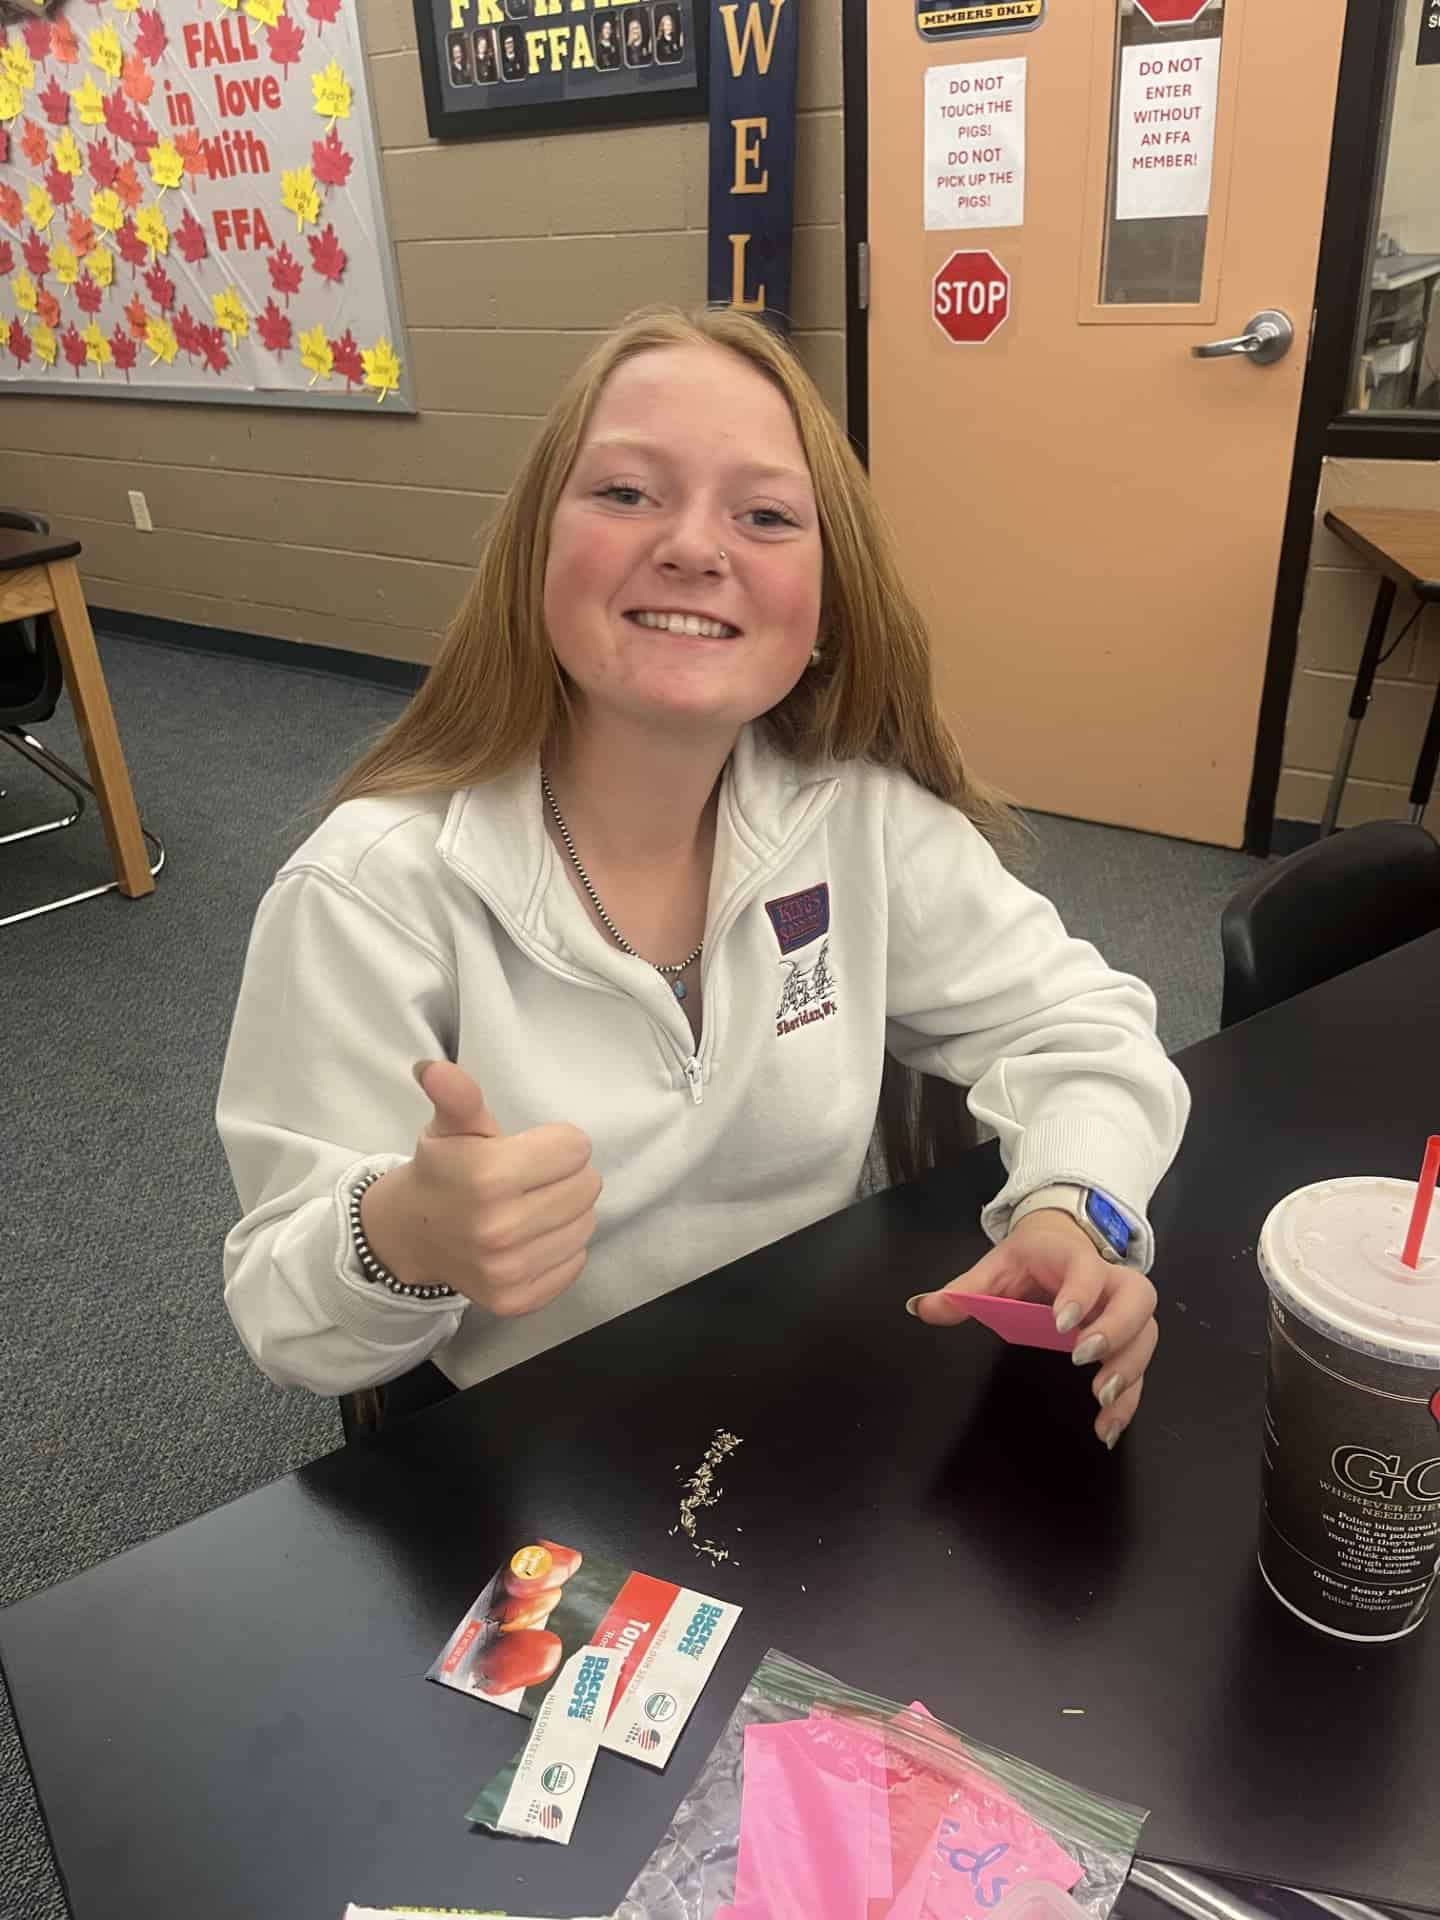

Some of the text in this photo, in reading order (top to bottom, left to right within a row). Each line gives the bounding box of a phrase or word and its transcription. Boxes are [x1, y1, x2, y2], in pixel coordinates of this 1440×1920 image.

[924, 4, 1035, 25] MEMBERS ONLY
[183, 15, 258, 69] FALL
[525, 24, 594, 74] FFA
[1139, 57, 1202, 76] DO NOT
[949, 76, 1004, 94] DO NOT
[1146, 84, 1192, 99] ENTER
[163, 79, 195, 126] in
[214, 74, 281, 117] love
[940, 100, 1013, 119] TOUCH THE
[1134, 107, 1201, 123] WITHOUT
[958, 125, 992, 138] PIGS!
[1140, 131, 1191, 147] AN FFA
[201, 129, 270, 180] With
[718, 0, 784, 313] WEL
[948, 148, 1002, 165] DO NOT
[1132, 154, 1197, 169] MEMBER!
[937, 171, 1014, 189] PICK UP THE
[958, 195, 991, 209] PIGS!
[212, 207, 275, 251] FFA
[936, 280, 1006, 315] STOP
[1319, 1479, 1402, 1512] WHEREVER
[1339, 1512, 1372, 1526] Police
[1375, 1522, 1405, 1532] bikes
[1362, 1507, 1422, 1520] NEEDED
[1328, 1532, 1356, 1546] more
[1338, 1521, 1371, 1535] quick
[1390, 1532, 1421, 1541] police
[1355, 1534, 1373, 1543] but
[1337, 1551, 1382, 1568] through
[1341, 1561, 1361, 1571] and
[1313, 1570, 1348, 1590] Officer
[1351, 1586, 1385, 1596] Jenny
[677, 1602, 711, 1655] ROOTS
[694, 1605, 724, 1648] BACK
[568, 1655, 596, 1718] ROOTS
[587, 1656, 610, 1707] BACK
